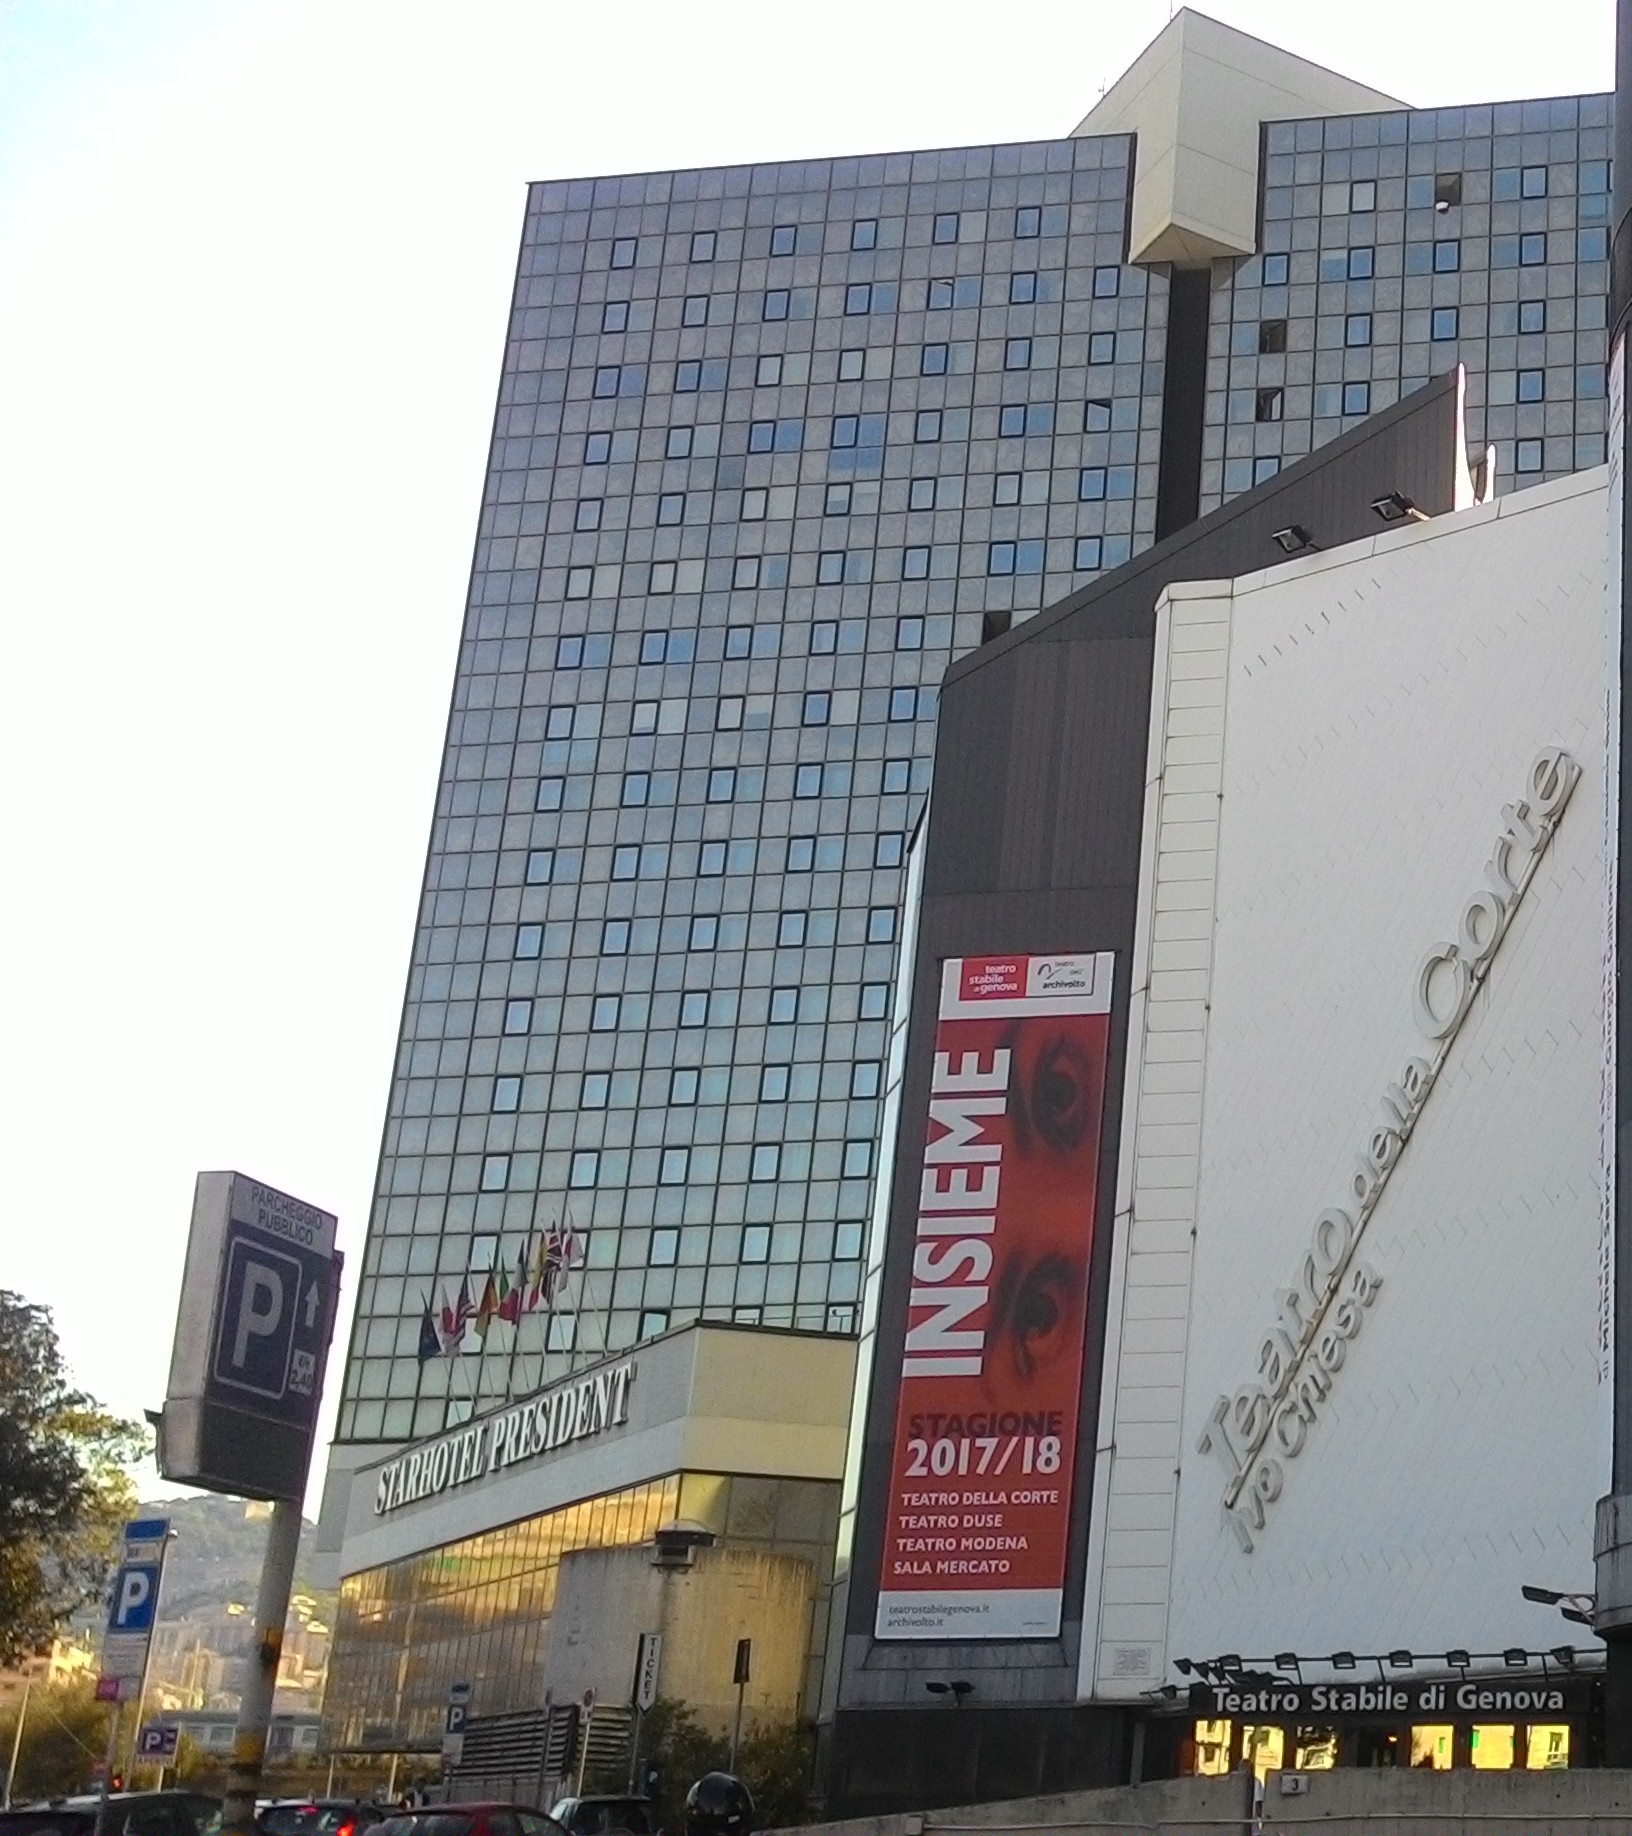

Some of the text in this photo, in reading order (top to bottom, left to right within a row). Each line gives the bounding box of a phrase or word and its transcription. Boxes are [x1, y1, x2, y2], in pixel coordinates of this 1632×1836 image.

[968, 974, 1005, 986] stabile
[985, 965, 1018, 974] teatro
[980, 982, 1018, 995] genova
[1198, 745, 1582, 1483] Teatro della Corte
[251, 1186, 323, 1231] PARCHEGGIO
[901, 1047, 1013, 1379] INSIEME
[258, 1208, 314, 1246] PUBBLICO
[231, 1261, 284, 1368] P
[1275, 1266, 1384, 1458] Chiesa
[374, 1362, 634, 1516] STARHOTEL PRESIDENT
[908, 1411, 1064, 1439] STAGIONE
[904, 1435, 1062, 1478] 2017/18
[901, 1491, 1059, 1507] TEATRO DELLA CORTE
[898, 1514, 1003, 1529] TEATRO DUSE
[896, 1536, 1029, 1552] TEATRO MODENA
[893, 1560, 1010, 1575] SALA MERCATO
[116, 1571, 150, 1626] P
[887, 1618, 944, 1628] archivolto.it
[644, 1637, 658, 1700] TICKET
[1212, 1684, 1564, 1713] Teatro Stabile di Genova
